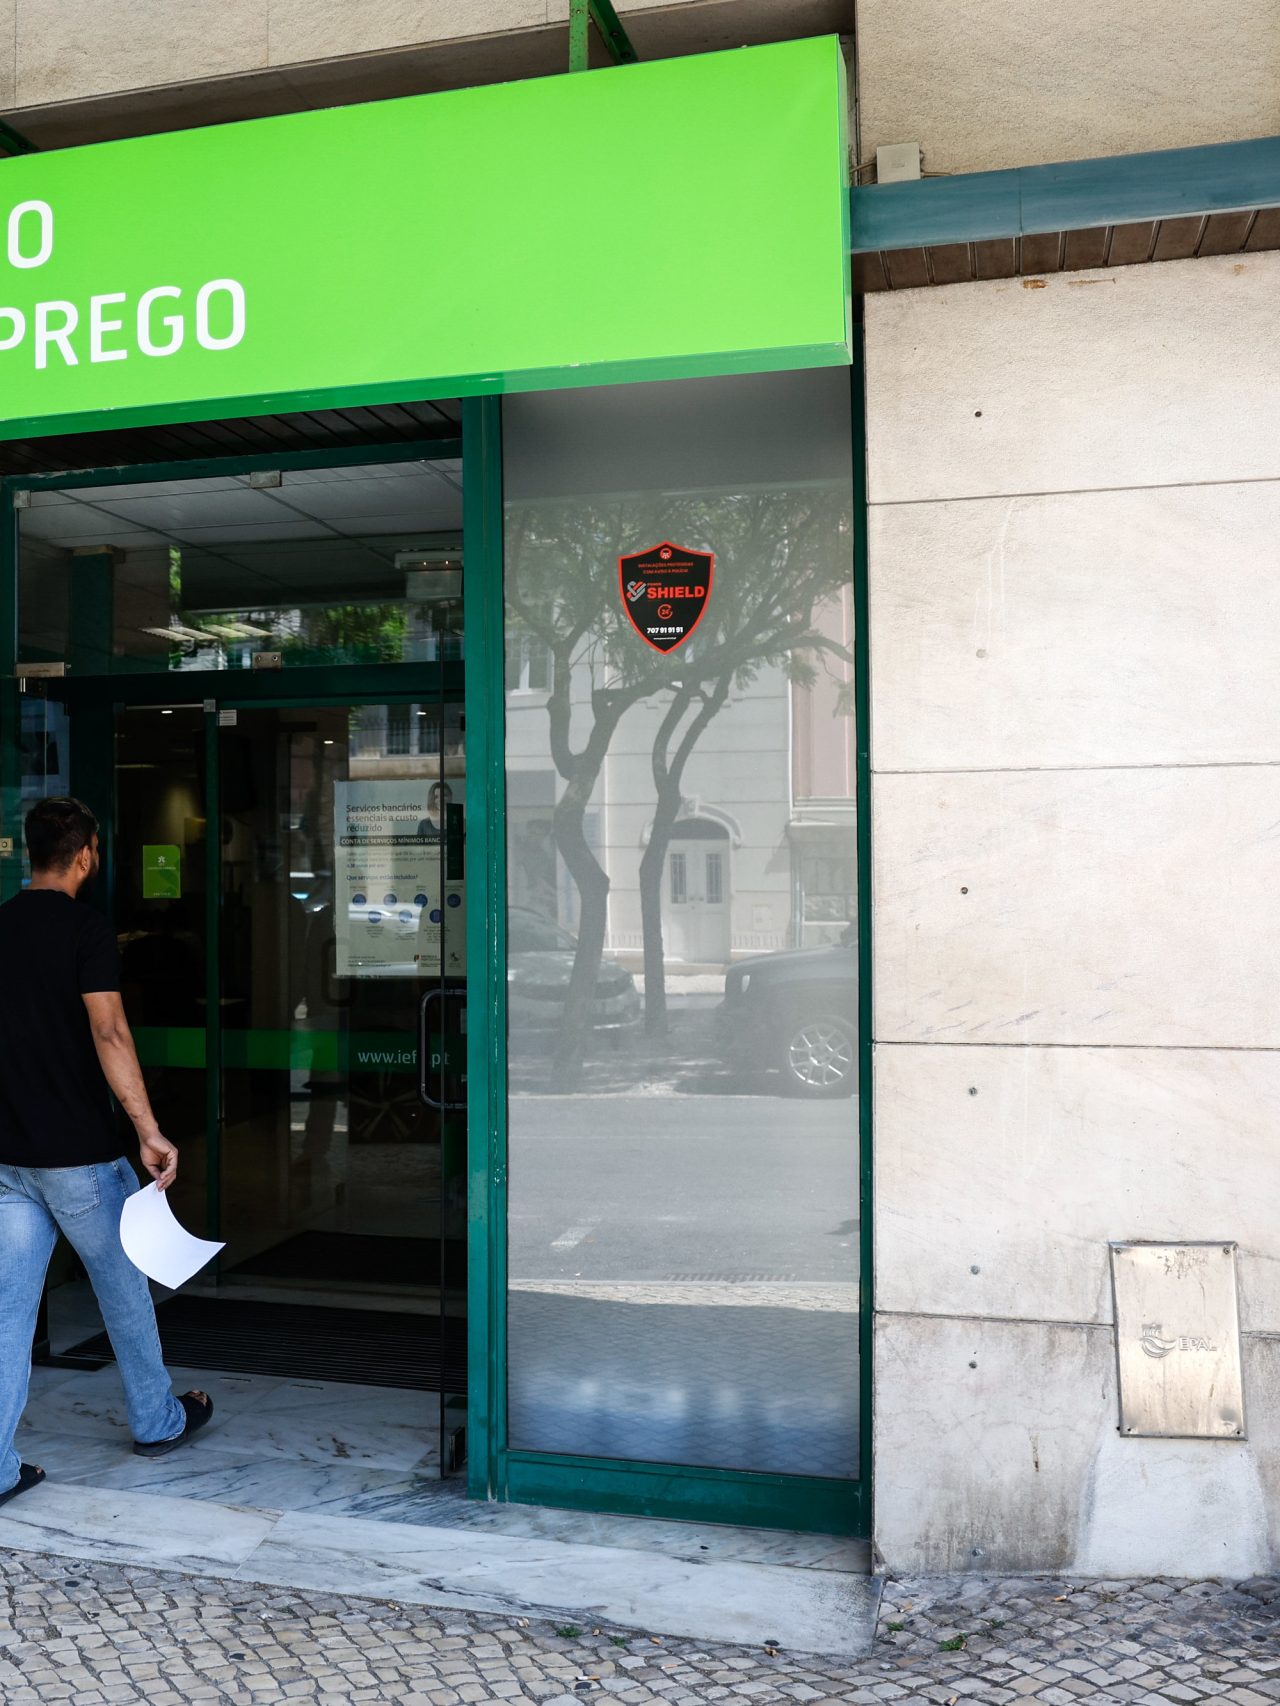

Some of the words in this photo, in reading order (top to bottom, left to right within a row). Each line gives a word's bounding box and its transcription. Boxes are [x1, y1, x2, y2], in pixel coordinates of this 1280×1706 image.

[647, 586, 705, 599] SHIELD
[346, 804, 380, 814] Serviços
[382, 803, 422, 812] bancários
[395, 814, 418, 822] custo
[346, 823, 383, 832] reduzido
[370, 838, 397, 846] SERVIÇOS
[1179, 1336, 1217, 1351] EPAL
